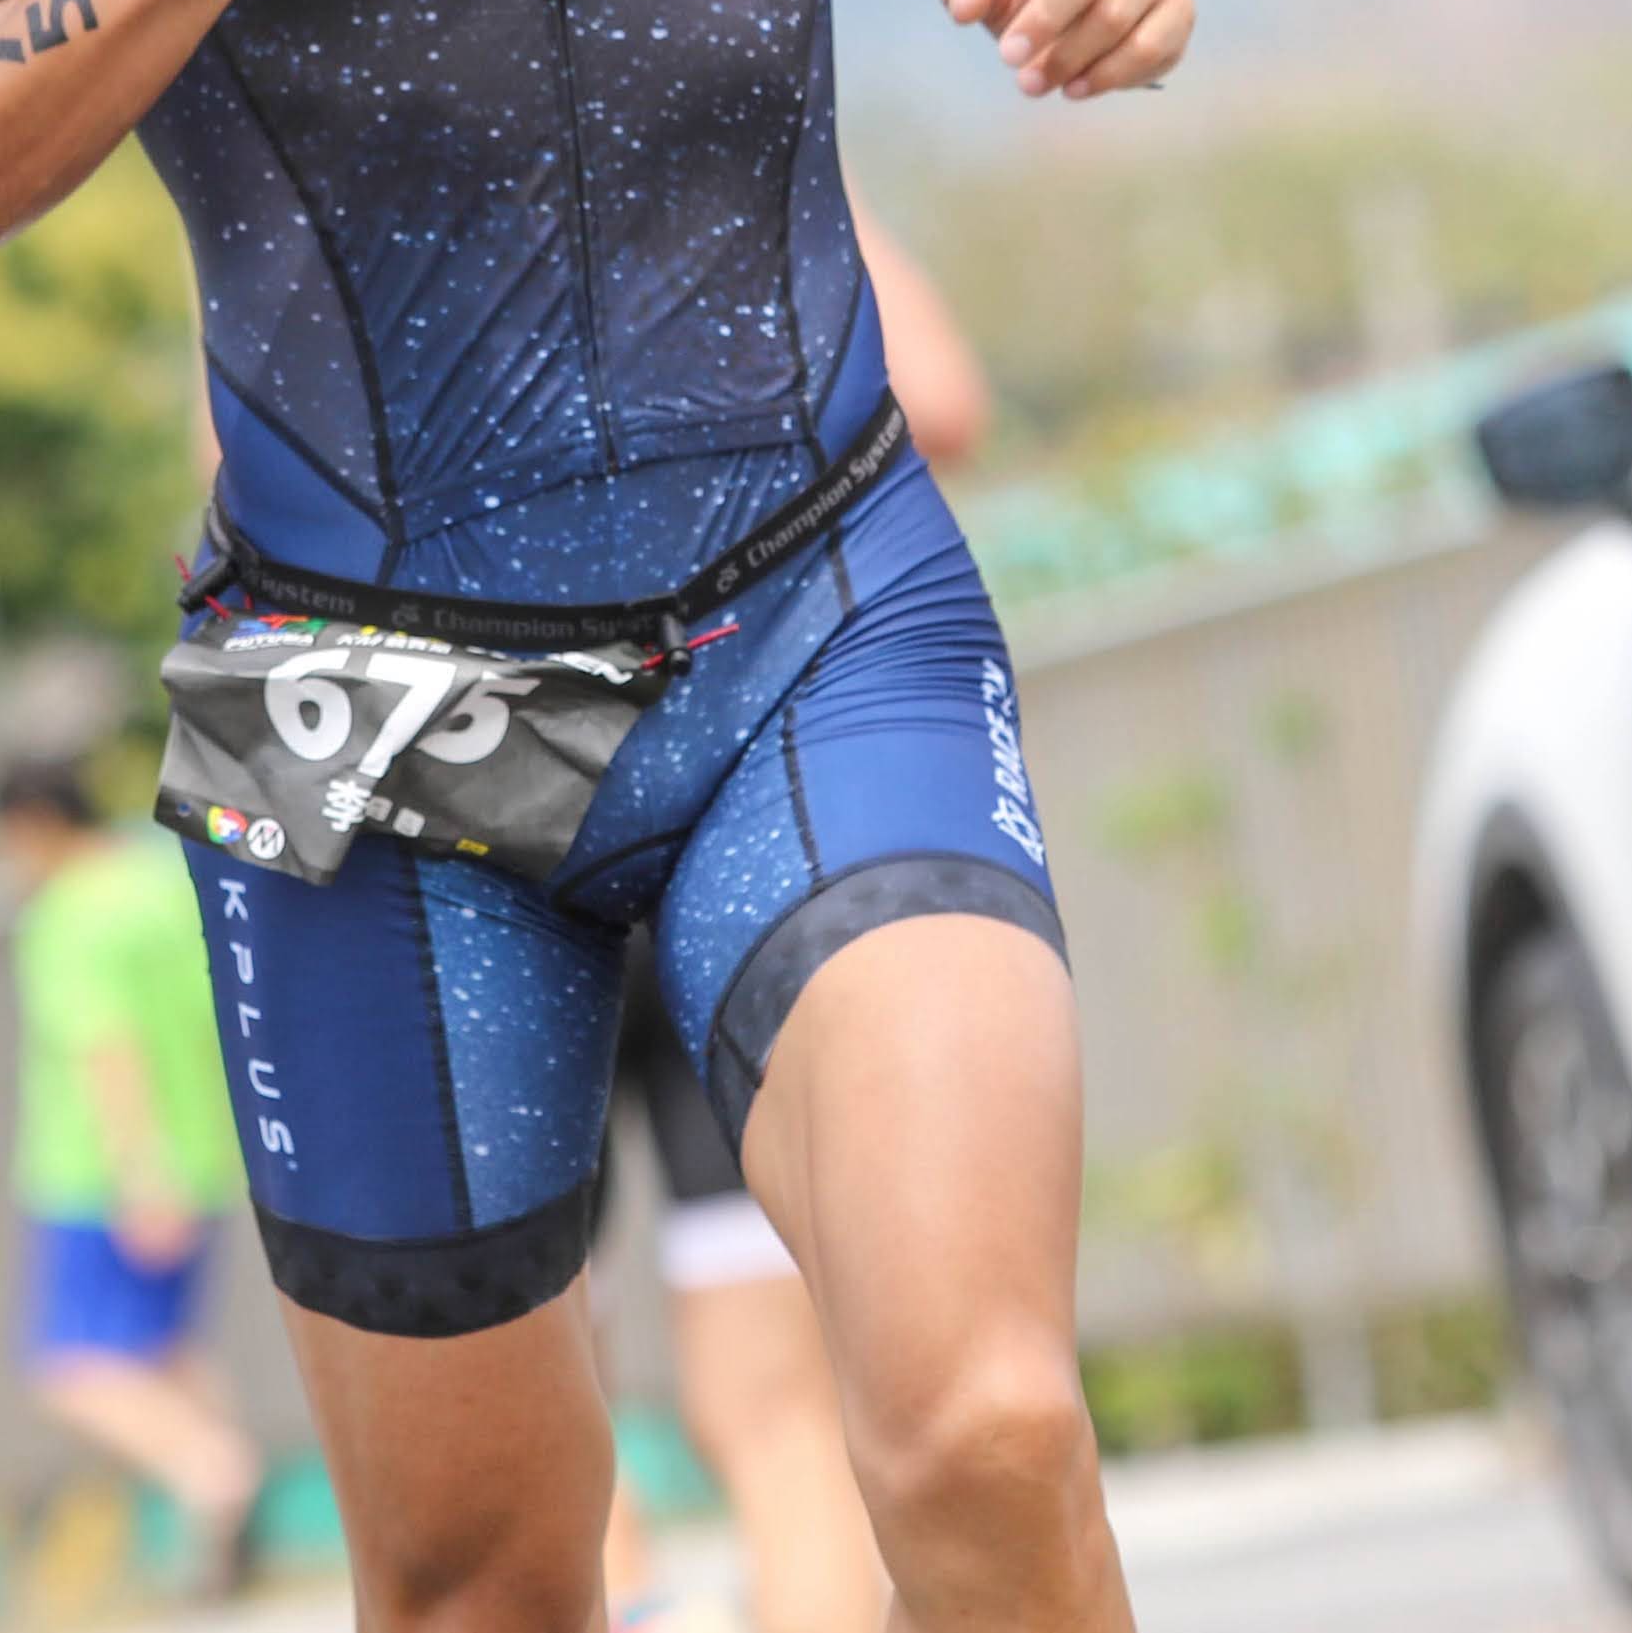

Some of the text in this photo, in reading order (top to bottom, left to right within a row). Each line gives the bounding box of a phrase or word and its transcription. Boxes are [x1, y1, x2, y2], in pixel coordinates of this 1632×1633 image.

[747, 476, 854, 568] Champion
[263, 648, 541, 779] 675
[219, 877, 295, 1155] KPLUS
